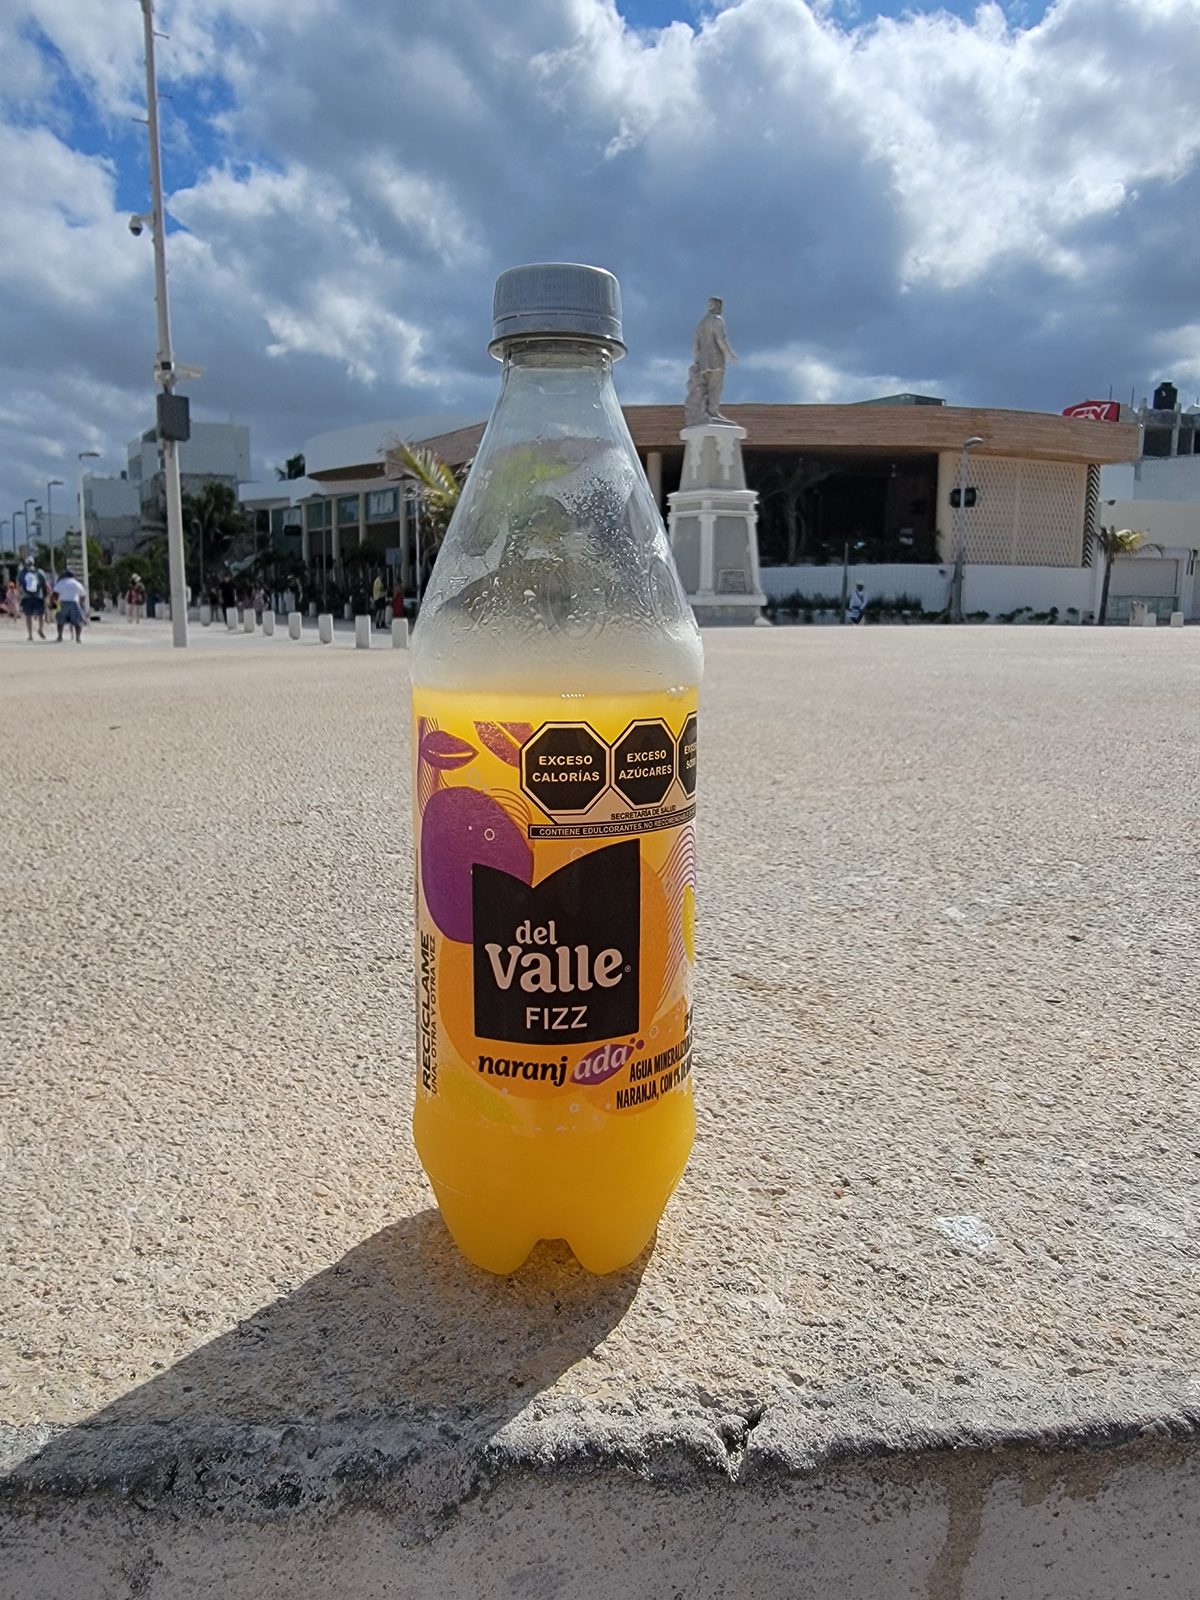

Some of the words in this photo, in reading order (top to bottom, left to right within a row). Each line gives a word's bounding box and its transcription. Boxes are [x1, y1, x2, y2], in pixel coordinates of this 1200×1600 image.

[538, 755, 593, 766] EXCESO
[627, 749, 667, 763] EXCESO
[532, 769, 600, 783] CALORÍAS
[618, 763, 672, 780] AZÚCARES
[610, 809, 652, 821] SECRETARÍA
[652, 807, 660, 816] DE
[660, 804, 677, 814] SALUD
[539, 827, 581, 836] CONTIENE
[643, 820, 653, 829] NO
[515, 919, 557, 945] del
[420, 929, 431, 1091] RECÍCLAME
[430, 1006, 436, 1017] Y
[526, 1005, 588, 1030] FIZZ
[629, 1057, 653, 1082] AGUA
[616, 1079, 659, 1110] NARANJA,
[660, 1070, 673, 1095] CON
